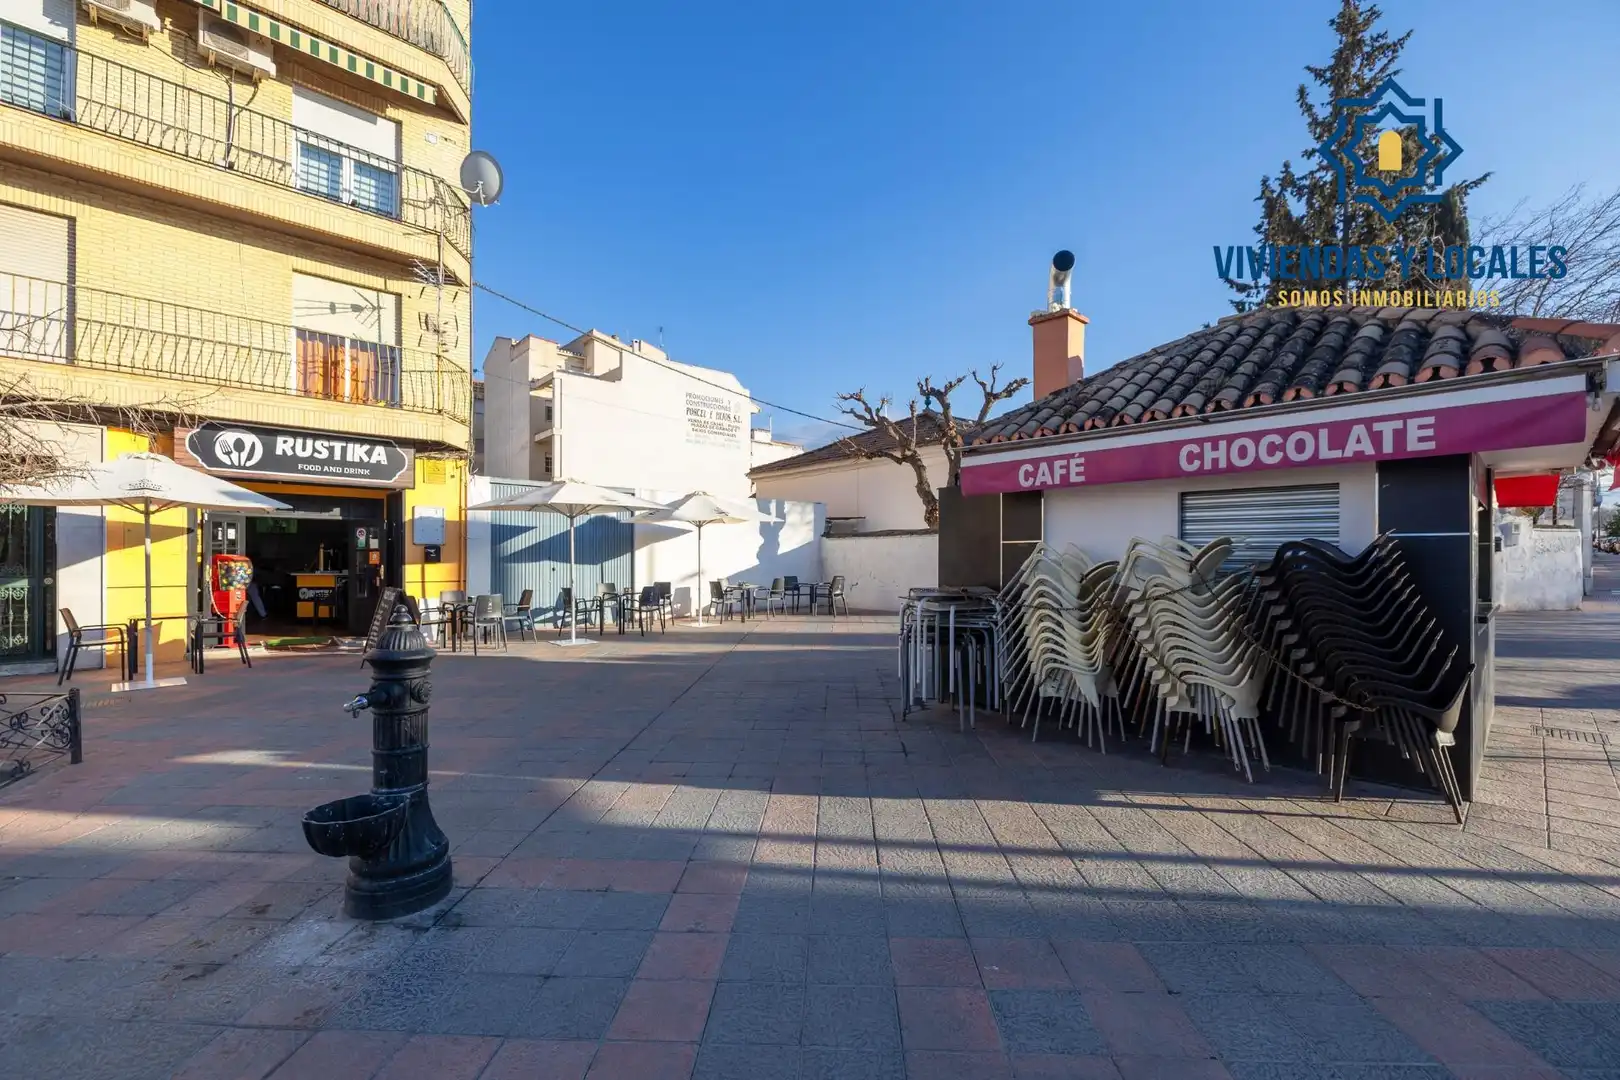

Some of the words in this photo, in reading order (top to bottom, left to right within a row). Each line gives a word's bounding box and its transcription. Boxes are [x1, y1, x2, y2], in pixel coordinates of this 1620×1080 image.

[275, 435, 388, 465] RUSTIKA
[1018, 453, 1085, 488] CAFÉ
[1179, 416, 1436, 472] CHOCOLATE
[298, 463, 321, 472] FOOD
[323, 466, 342, 474] AND
[343, 467, 371, 476] DRINK
